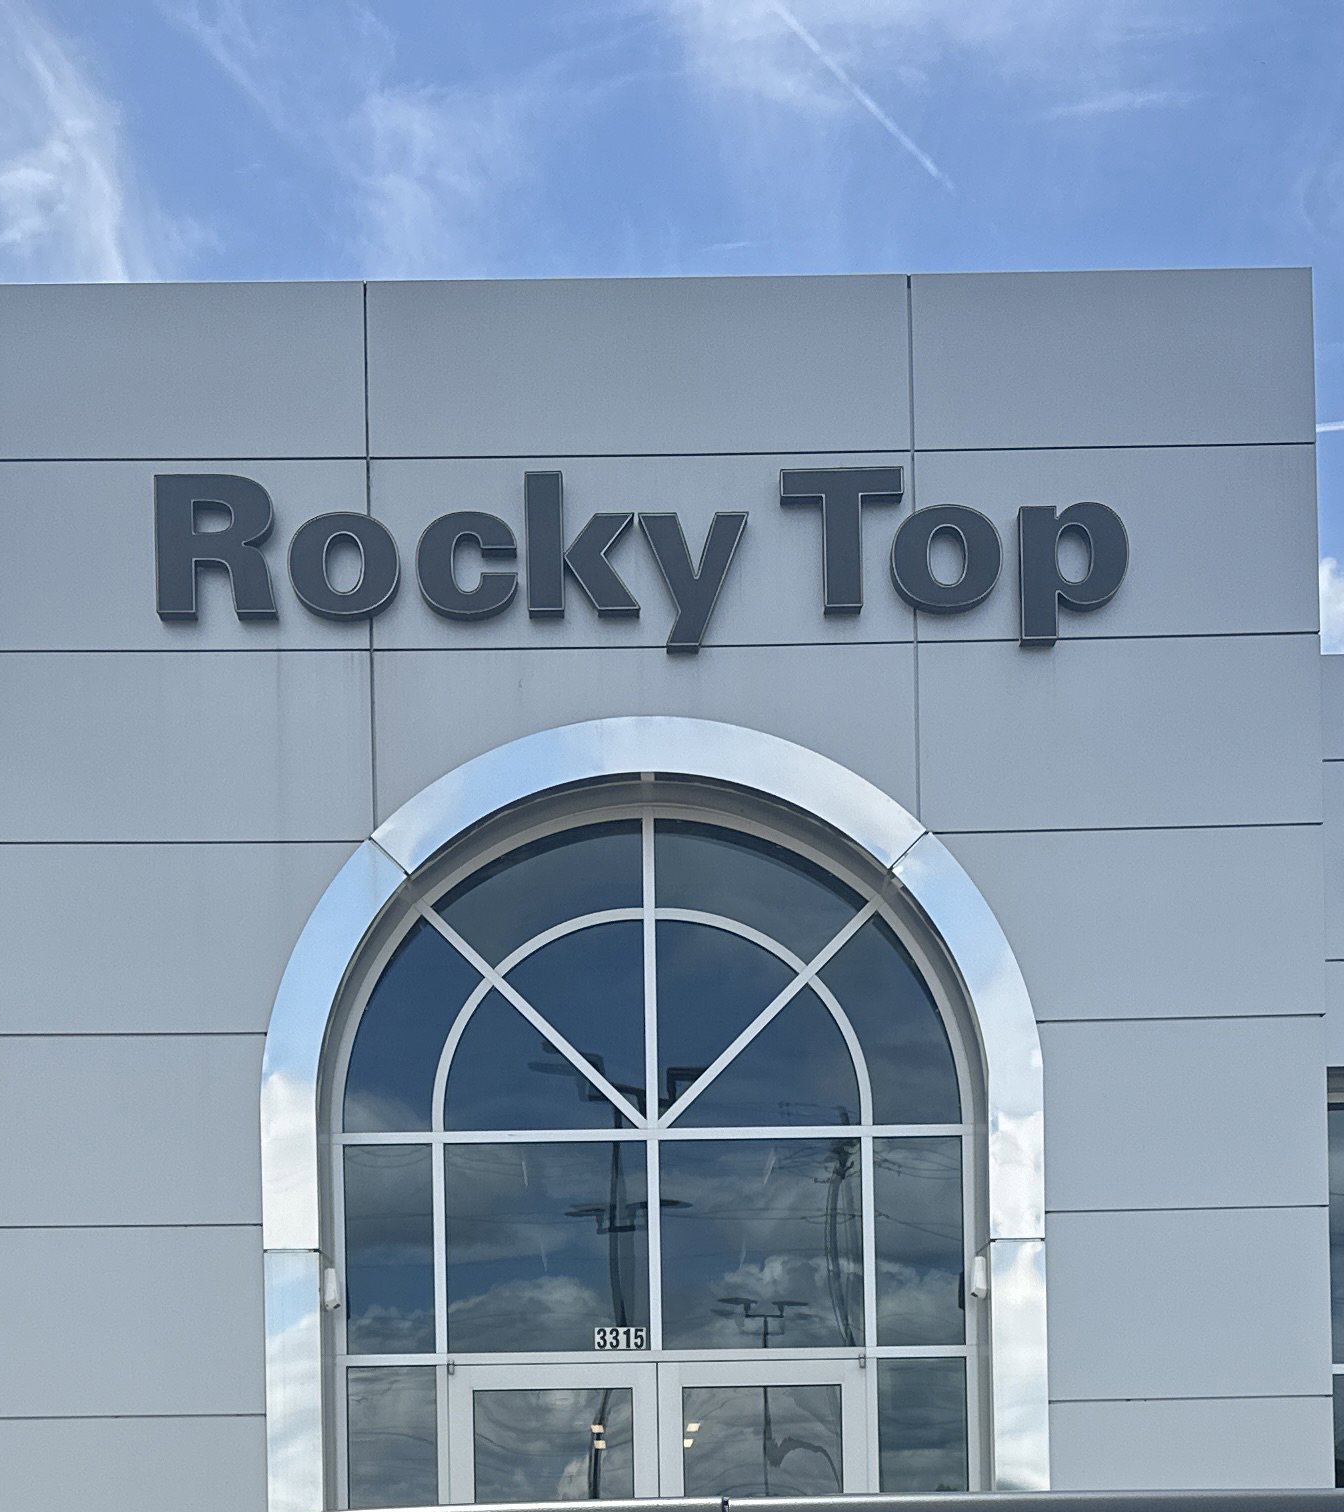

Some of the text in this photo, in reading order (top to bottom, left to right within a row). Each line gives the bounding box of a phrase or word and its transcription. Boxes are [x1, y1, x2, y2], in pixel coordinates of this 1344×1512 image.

[153, 465, 1130, 655] Rocky Top
[596, 1327, 645, 1349] 3315
